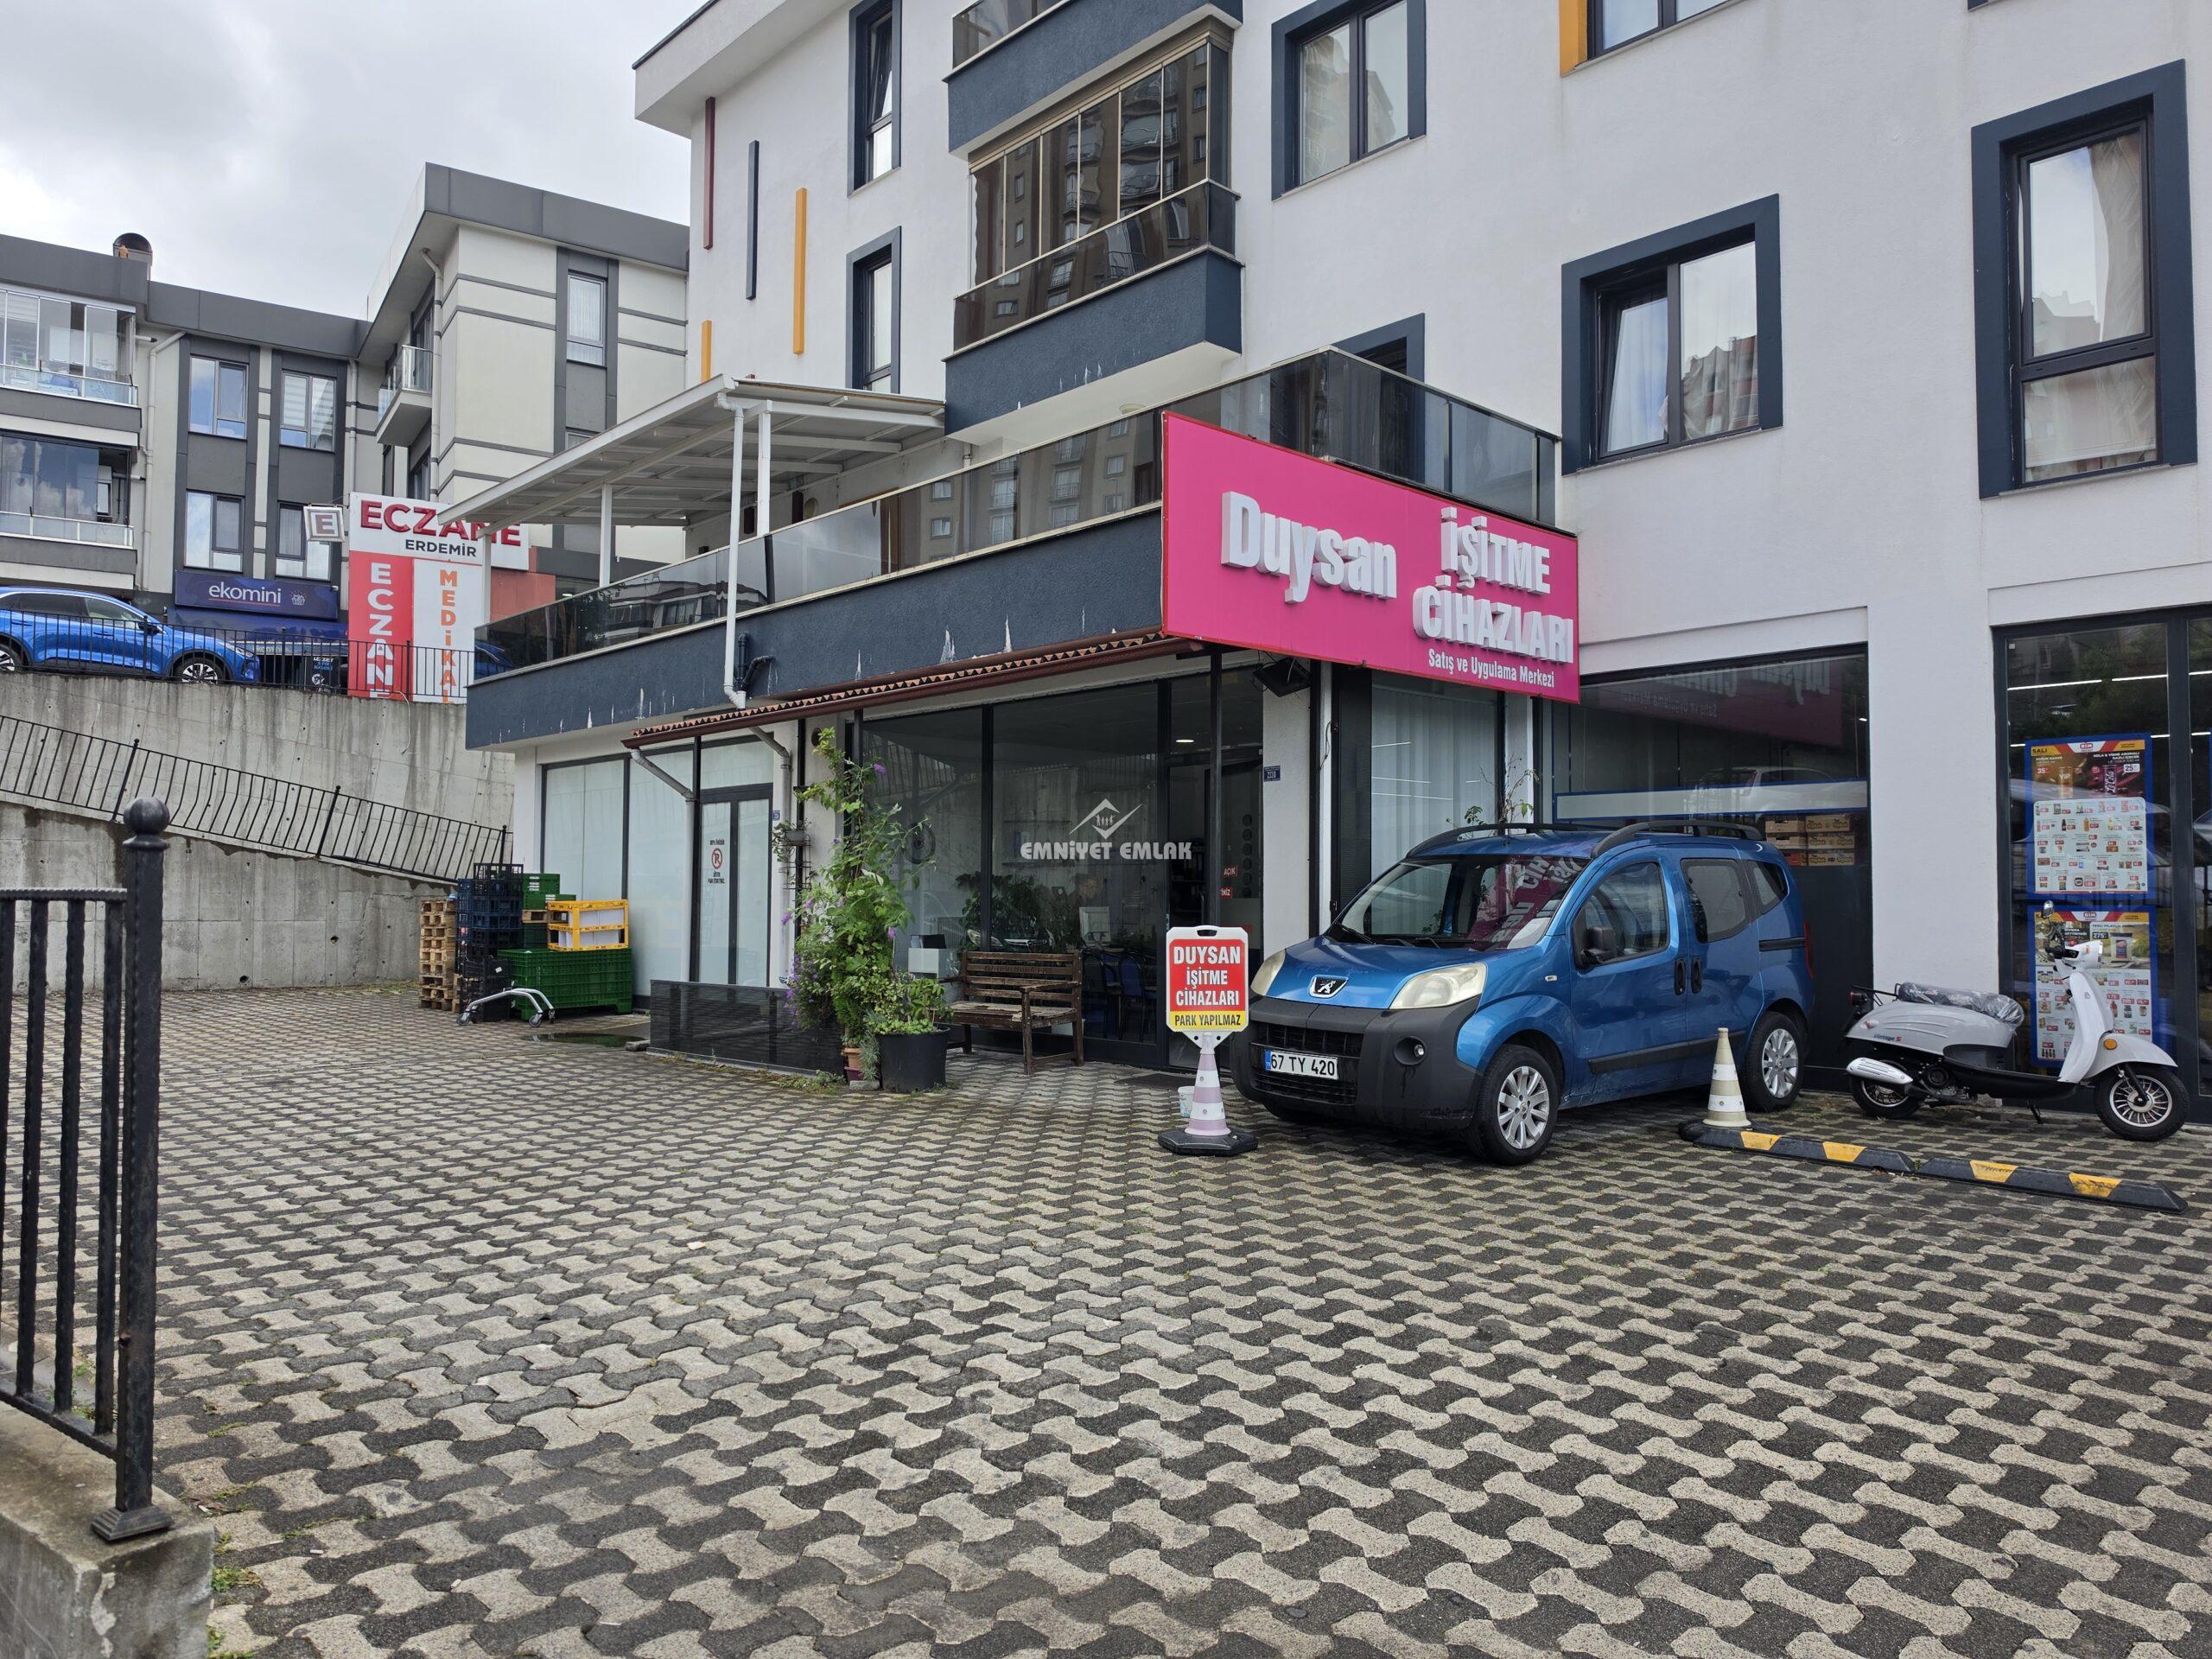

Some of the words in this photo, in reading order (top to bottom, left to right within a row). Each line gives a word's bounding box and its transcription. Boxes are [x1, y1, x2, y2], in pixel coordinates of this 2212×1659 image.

[315, 514, 335, 534] E
[405, 539, 476, 557] ERDEMİR
[1221, 491, 1396, 604] Duysan
[1440, 506, 1550, 594] İŞİTME
[209, 582, 281, 603] ekomini
[1413, 575, 1573, 664] CİHAZLARI
[440, 569, 457, 704] MEDİKAL
[1428, 648, 1454, 675] Satış
[1456, 657, 1468, 672] ve
[1471, 656, 1517, 680] Uygulama
[1520, 664, 1555, 688] Merkezi
[1119, 842, 1192, 860] EMLAK
[1173, 945, 1241, 964] DUYSAN
[1186, 966, 1228, 989] İŞİTME
[1176, 987, 1239, 1006] CİHAZLARI
[1175, 1014, 1197, 1027] PARK
[1198, 1014, 1241, 1027] YAPILMAZ
[1271, 1054, 1284, 1070] 67
[1288, 1056, 1306, 1073] TY
[1312, 1058, 1335, 1076] 420
